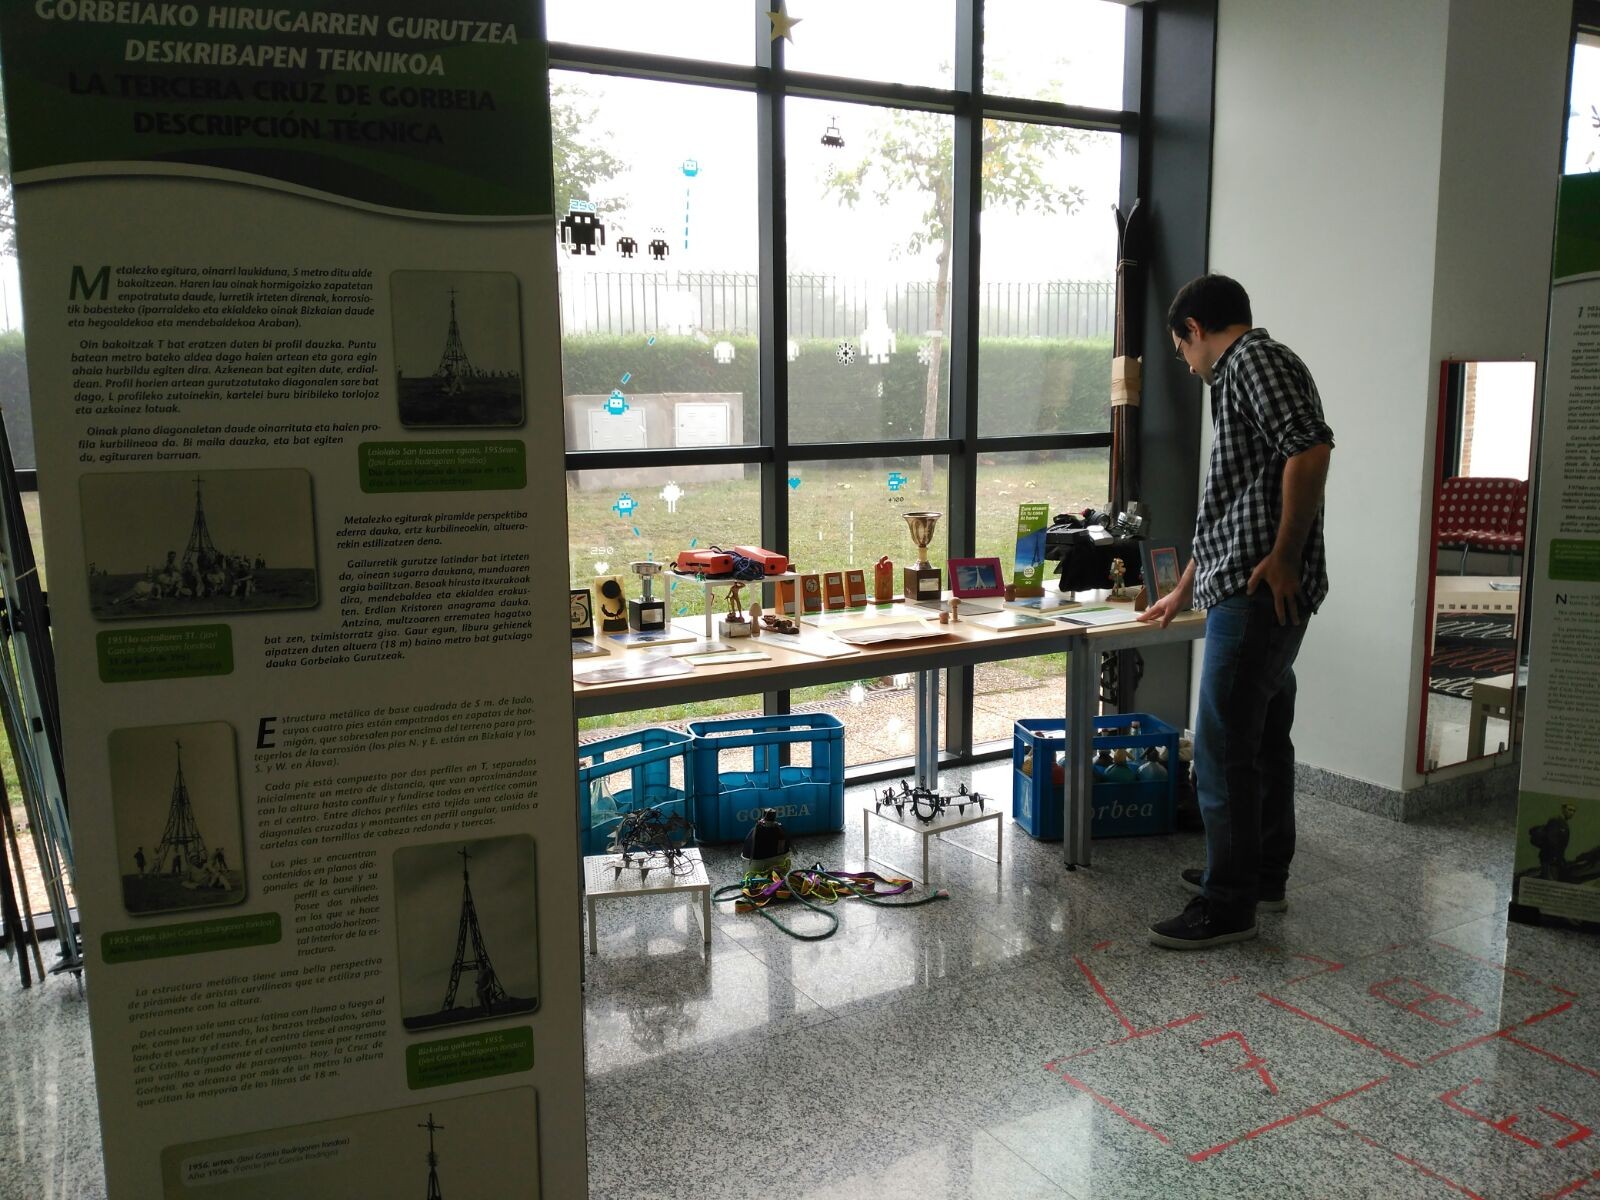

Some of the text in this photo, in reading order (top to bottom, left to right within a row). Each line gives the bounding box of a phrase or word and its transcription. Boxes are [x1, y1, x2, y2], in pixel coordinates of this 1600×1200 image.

[35, 0, 519, 46] GORBEIAKO HIRUGARREN GURUTZEA
[124, 39, 446, 77] DESKRIBAPEN TEKNIKOA
[67, 72, 497, 113] LA TERCERA CRUZ DE GORBEIA
[133, 108, 444, 144] DESCRIPCIÓN TÉCNICA
[115, 265, 159, 275] etalezko
[160, 266, 200, 277] egitura,
[201, 266, 236, 275] oinarri
[291, 267, 299, 276] 5
[300, 268, 329, 277] metro
[330, 267, 350, 277] ditu
[351, 268, 373, 278] alde
[179, 279, 210, 288] Haren
[212, 279, 228, 288] lau
[230, 279, 259, 289] oinak
[323, 281, 373, 292] zapatetan
[181, 291, 216, 302] daude,
[218, 292, 254, 302] lurretik
[256, 292, 288, 302] irteten
[289, 293, 329, 303] direnak,
[331, 293, 373, 303] korrosio-
[67, 304, 80, 314] tik
[82, 304, 135, 314] babesteko
[202, 306, 219, 314] eta
[221, 304, 268, 314] ekialdeko
[270, 305, 298, 315] oinak
[300, 305, 342, 315] Bizkaian
[343, 305, 375, 315] daude
[67, 319, 85, 327] eta
[156, 318, 173, 327] eta
[257, 317, 301, 329] Araban).
[79, 339, 377, 351] Oin bakoitzak T bat eratzen duten bi profil dauzka. Puntu
[71, 352, 377, 364] batean metro bateko aldea dago haien artean eta gora egin
[71, 364, 378, 376] ahala hurbildu egiten dira. Azkenean bat egiten dute, erdial-
[79, 452, 96, 463] du,
[156, 451, 201, 460] barruan.
[343, 514, 392, 524] Metalezko
[393, 513, 433, 525] egiturak
[434, 511, 475, 523] piramide
[335, 527, 366, 537] ederra
[369, 526, 401, 536] dauka,
[404, 526, 423, 534] ertz
[493, 522, 528, 531] altuera-
[336, 539, 360, 549] rekin
[416, 537, 442, 546] dena.
[400, 557, 438, 568] gurutze
[440, 554, 479, 564] latindar
[481, 553, 497, 562] bat
[500, 553, 530, 561] irteten
[341, 618, 382, 628] Antzina,
[443, 610, 491, 621] errematea
[493, 609, 532, 620] hagatxo
[265, 656, 297, 668] dauka
[300, 655, 350, 666] Gorbeiako
[282, 713, 326, 723] structura
[329, 709, 370, 719] metálica
[373, 707, 385, 716] de
[387, 706, 410, 715] base
[412, 701, 457, 712] cuadrada
[460, 700, 472, 709] de
[474, 699, 481, 708] 5
[497, 697, 510, 706] de
[511, 695, 534, 705] lado,
[1091, 799, 1153, 821] rbea
[135, 988, 148, 997] La
[206, 975, 249, 987] metálica
[252, 972, 276, 982] tiene
[279, 969, 299, 978] una
[302, 964, 326, 975] bella
